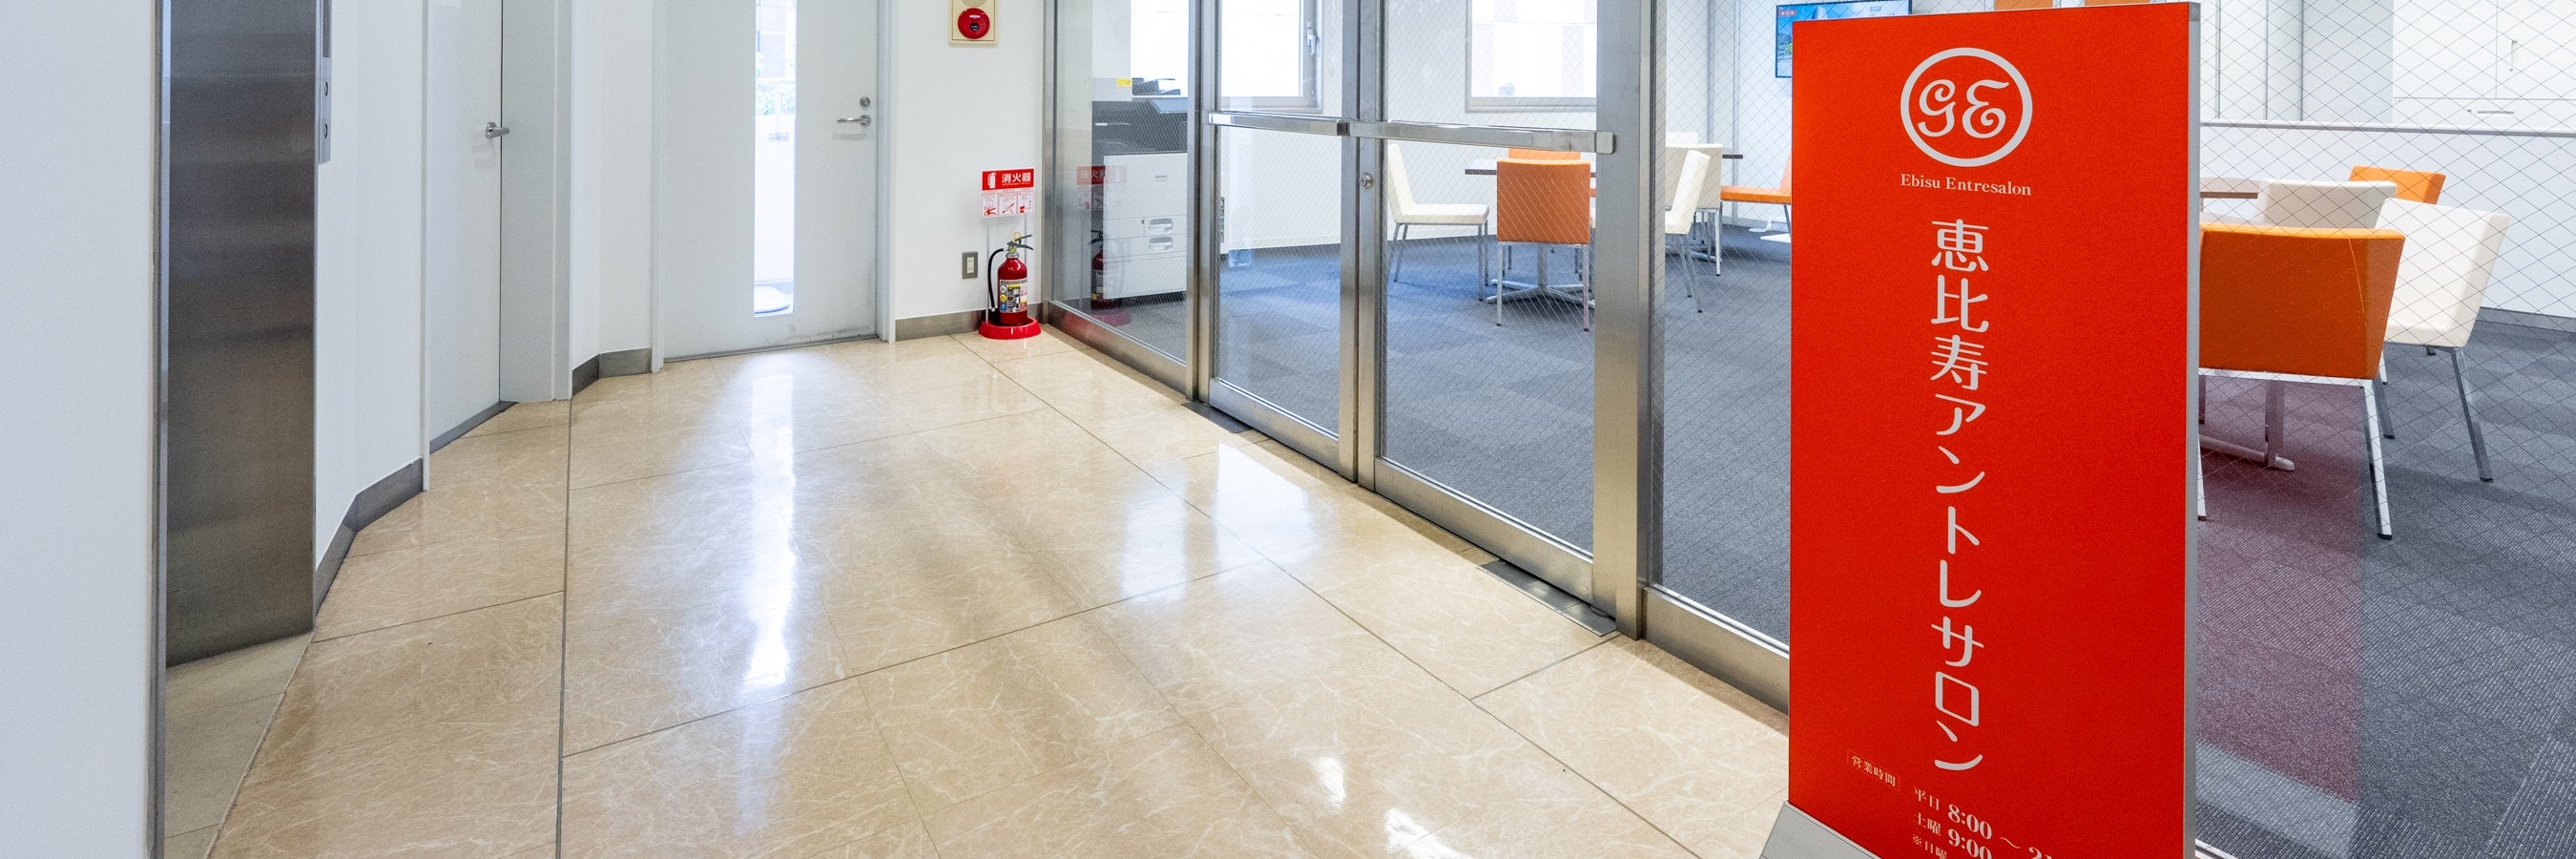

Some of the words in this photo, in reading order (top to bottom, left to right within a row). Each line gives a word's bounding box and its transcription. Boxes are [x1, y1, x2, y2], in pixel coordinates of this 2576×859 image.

[1002, 172, 1031, 183] 消火器
[1901, 174, 1941, 189] Ebisu
[1945, 177, 2031, 197] Entresalon
[1930, 219, 1989, 771] 恵比寿アントレサロン
[1852, 755, 1896, 787] 営業時間
[1914, 787, 1940, 810] 平日
[1947, 804, 1993, 840] 8:00
[1914, 812, 1942, 836] 土曜
[1947, 828, 1993, 859] 9:00
